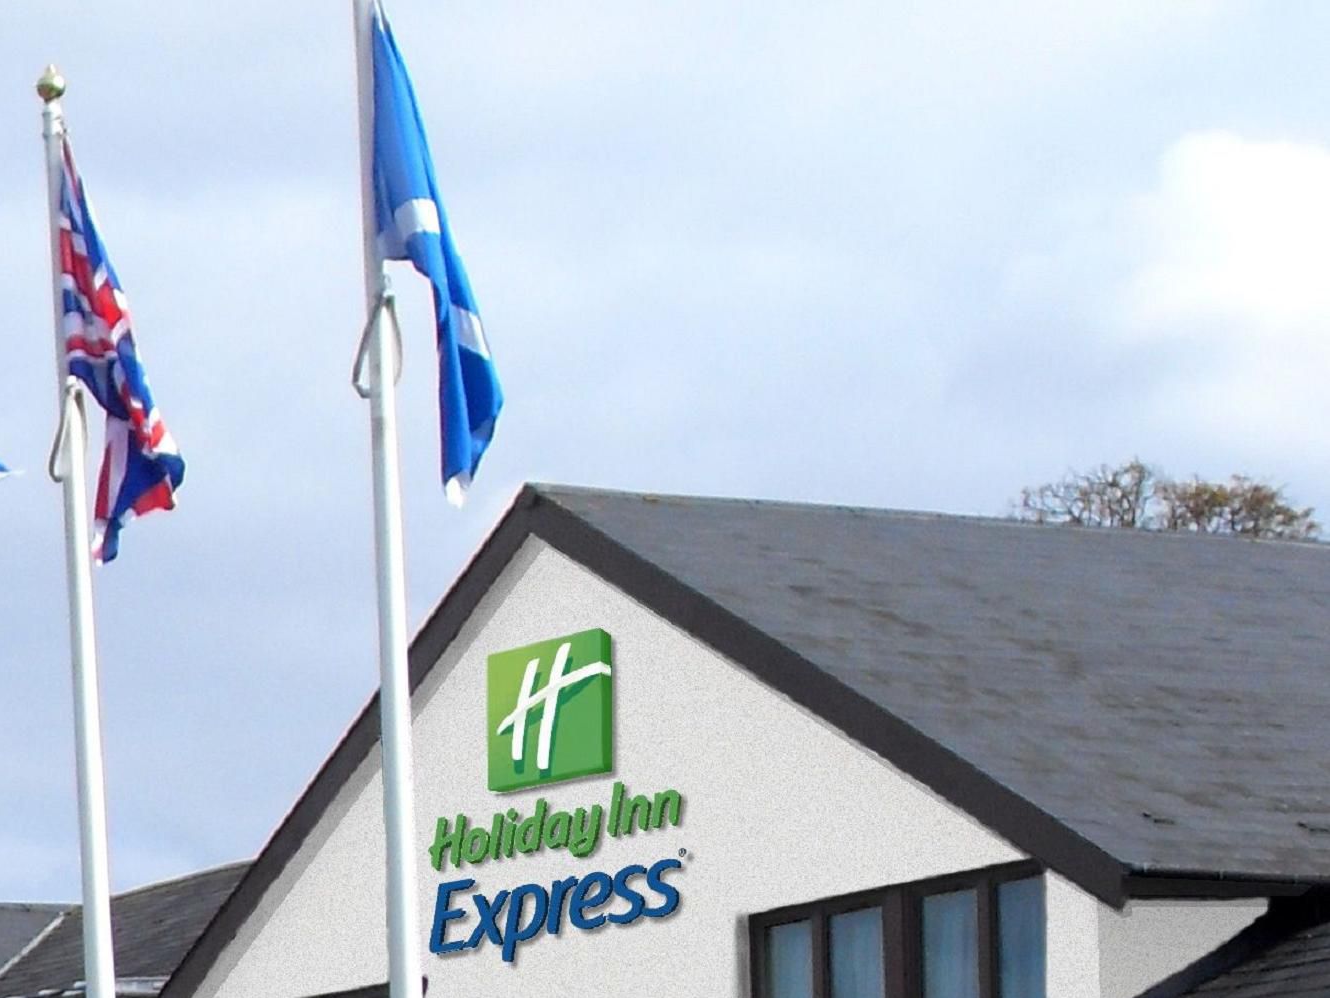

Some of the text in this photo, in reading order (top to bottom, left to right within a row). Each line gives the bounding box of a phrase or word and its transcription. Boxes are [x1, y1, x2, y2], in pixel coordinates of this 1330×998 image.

[429, 782, 683, 872] Holiday Inn
[429, 858, 682, 962] Express
